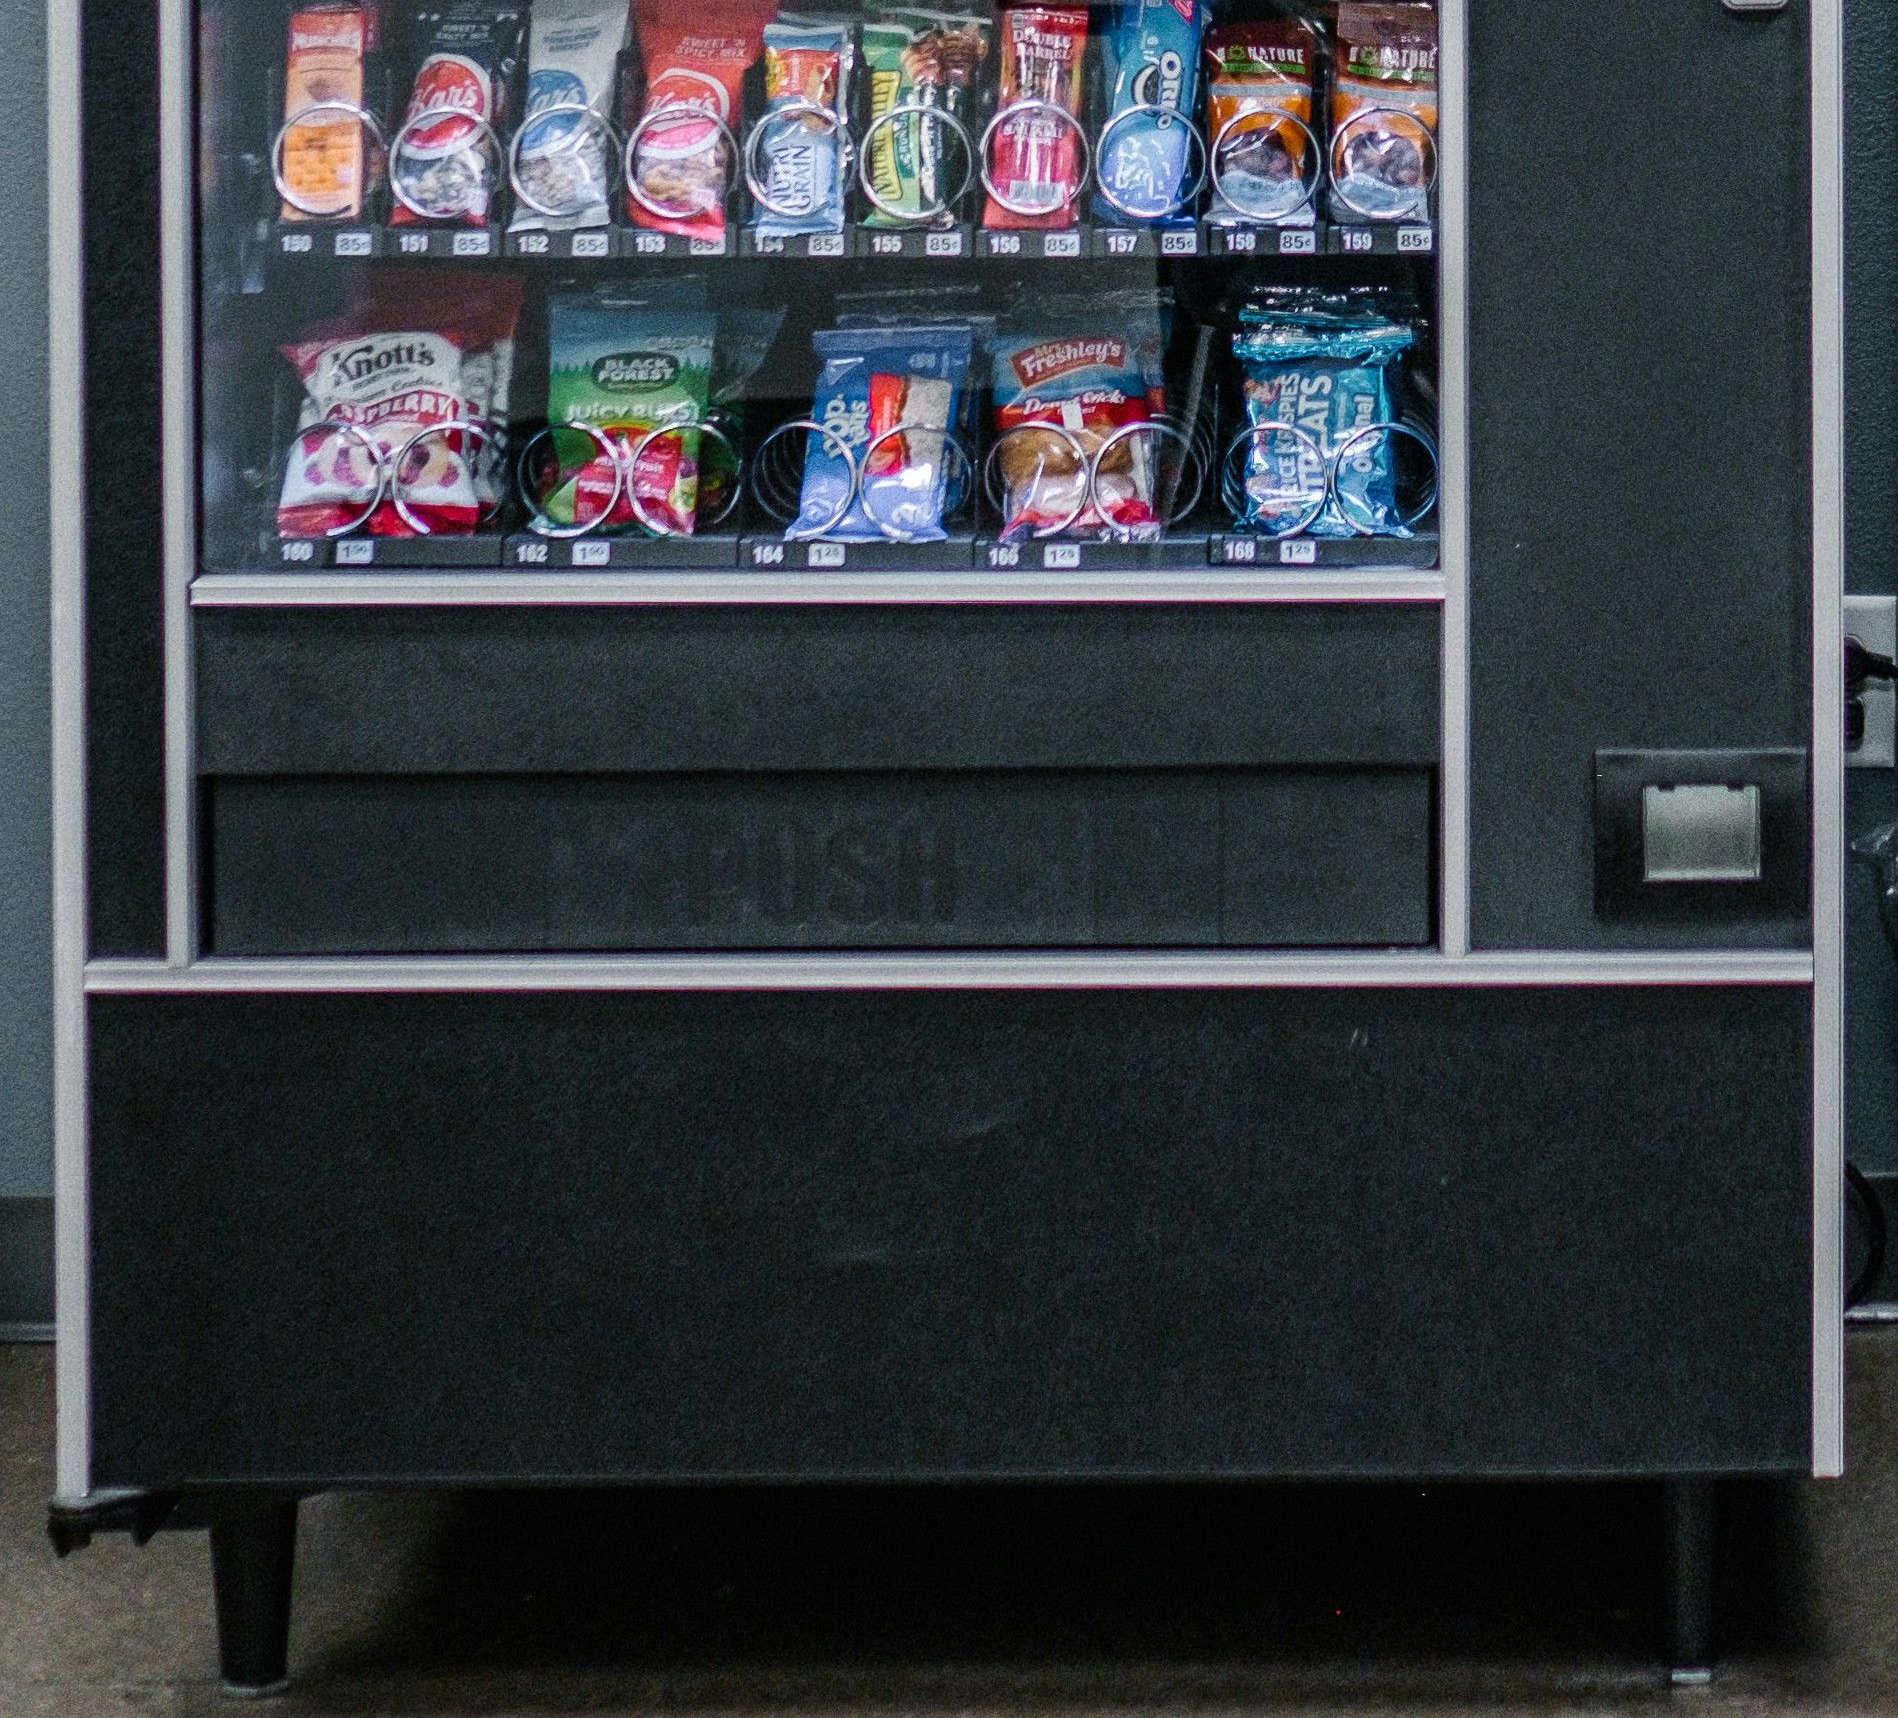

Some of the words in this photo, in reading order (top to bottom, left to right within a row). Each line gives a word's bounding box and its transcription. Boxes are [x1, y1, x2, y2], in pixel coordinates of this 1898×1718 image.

[674, 46, 715, 57] SPICY
[718, 48, 745, 59] MIX
[681, 36, 729, 49] SWEET
[1247, 45, 1305, 65] NATURE
[790, 144, 815, 210] GRAIN
[327, 342, 436, 388] Knott's
[604, 358, 669, 371] BLACK
[1021, 341, 1122, 379] Freshley's
[597, 368, 676, 383] FOREST
[563, 403, 629, 423] JUICY
[1275, 372, 1300, 454] KRISPIES
[692, 827, 957, 924] PUSH
